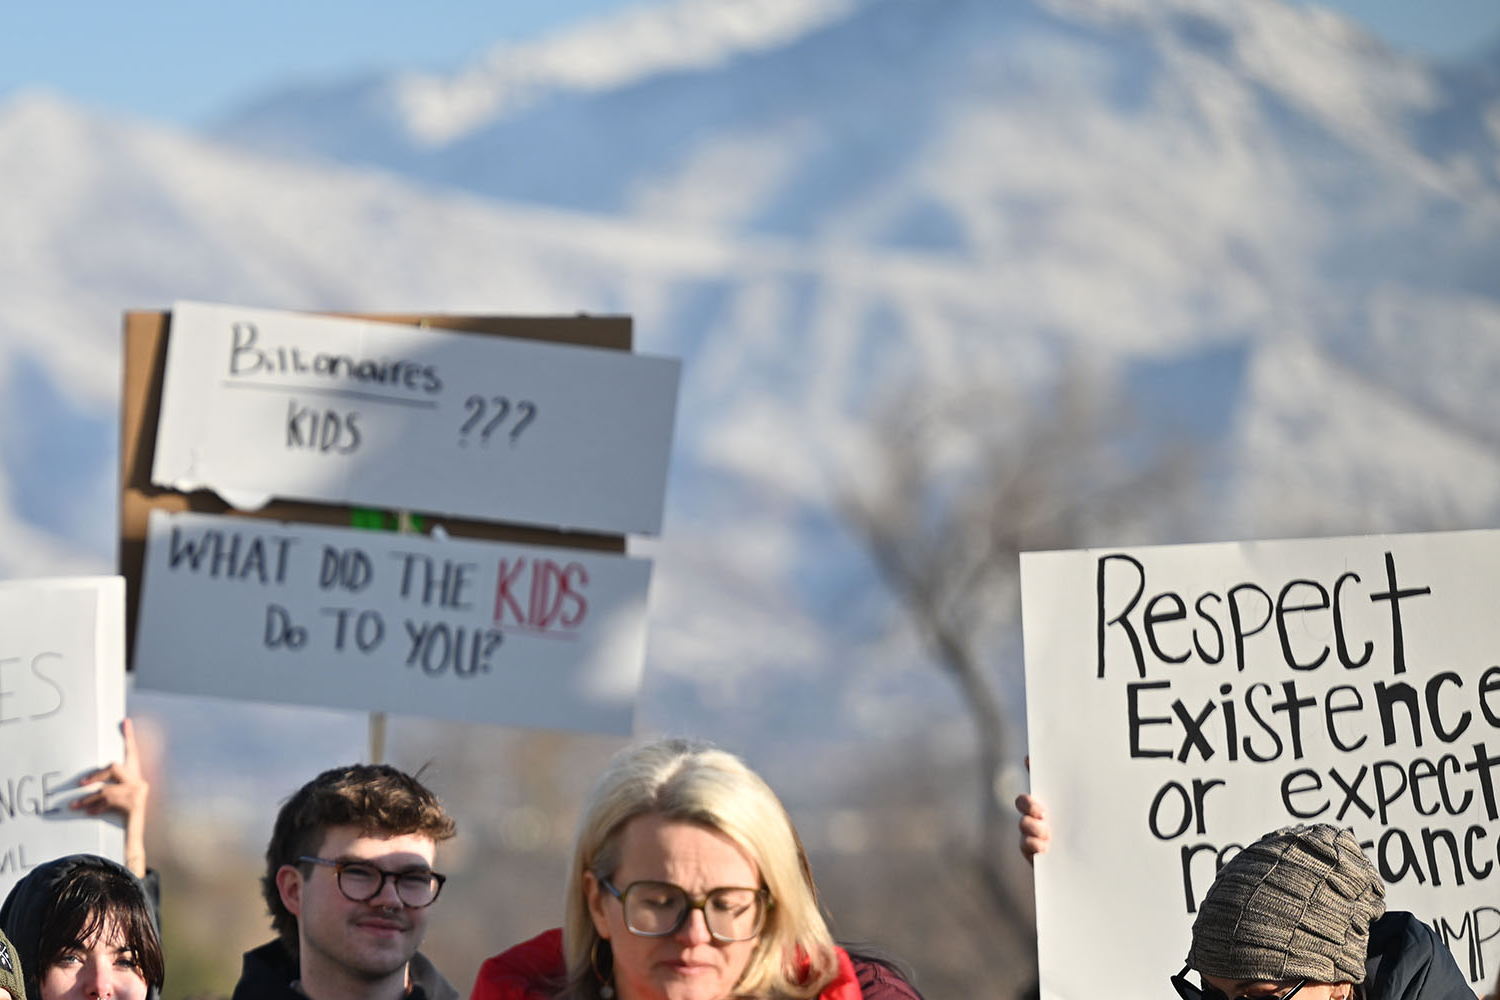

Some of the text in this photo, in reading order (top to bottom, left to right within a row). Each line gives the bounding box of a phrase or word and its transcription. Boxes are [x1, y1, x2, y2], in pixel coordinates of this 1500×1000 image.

[285, 394, 539, 455] KIDS ???
[168, 525, 590, 629] WHAT DID THE KIDS
[1097, 551, 1431, 678] Respect
[320, 605, 385, 653] TO
[404, 618, 504, 680] YOU?
[1148, 742, 1500, 841] or expect
